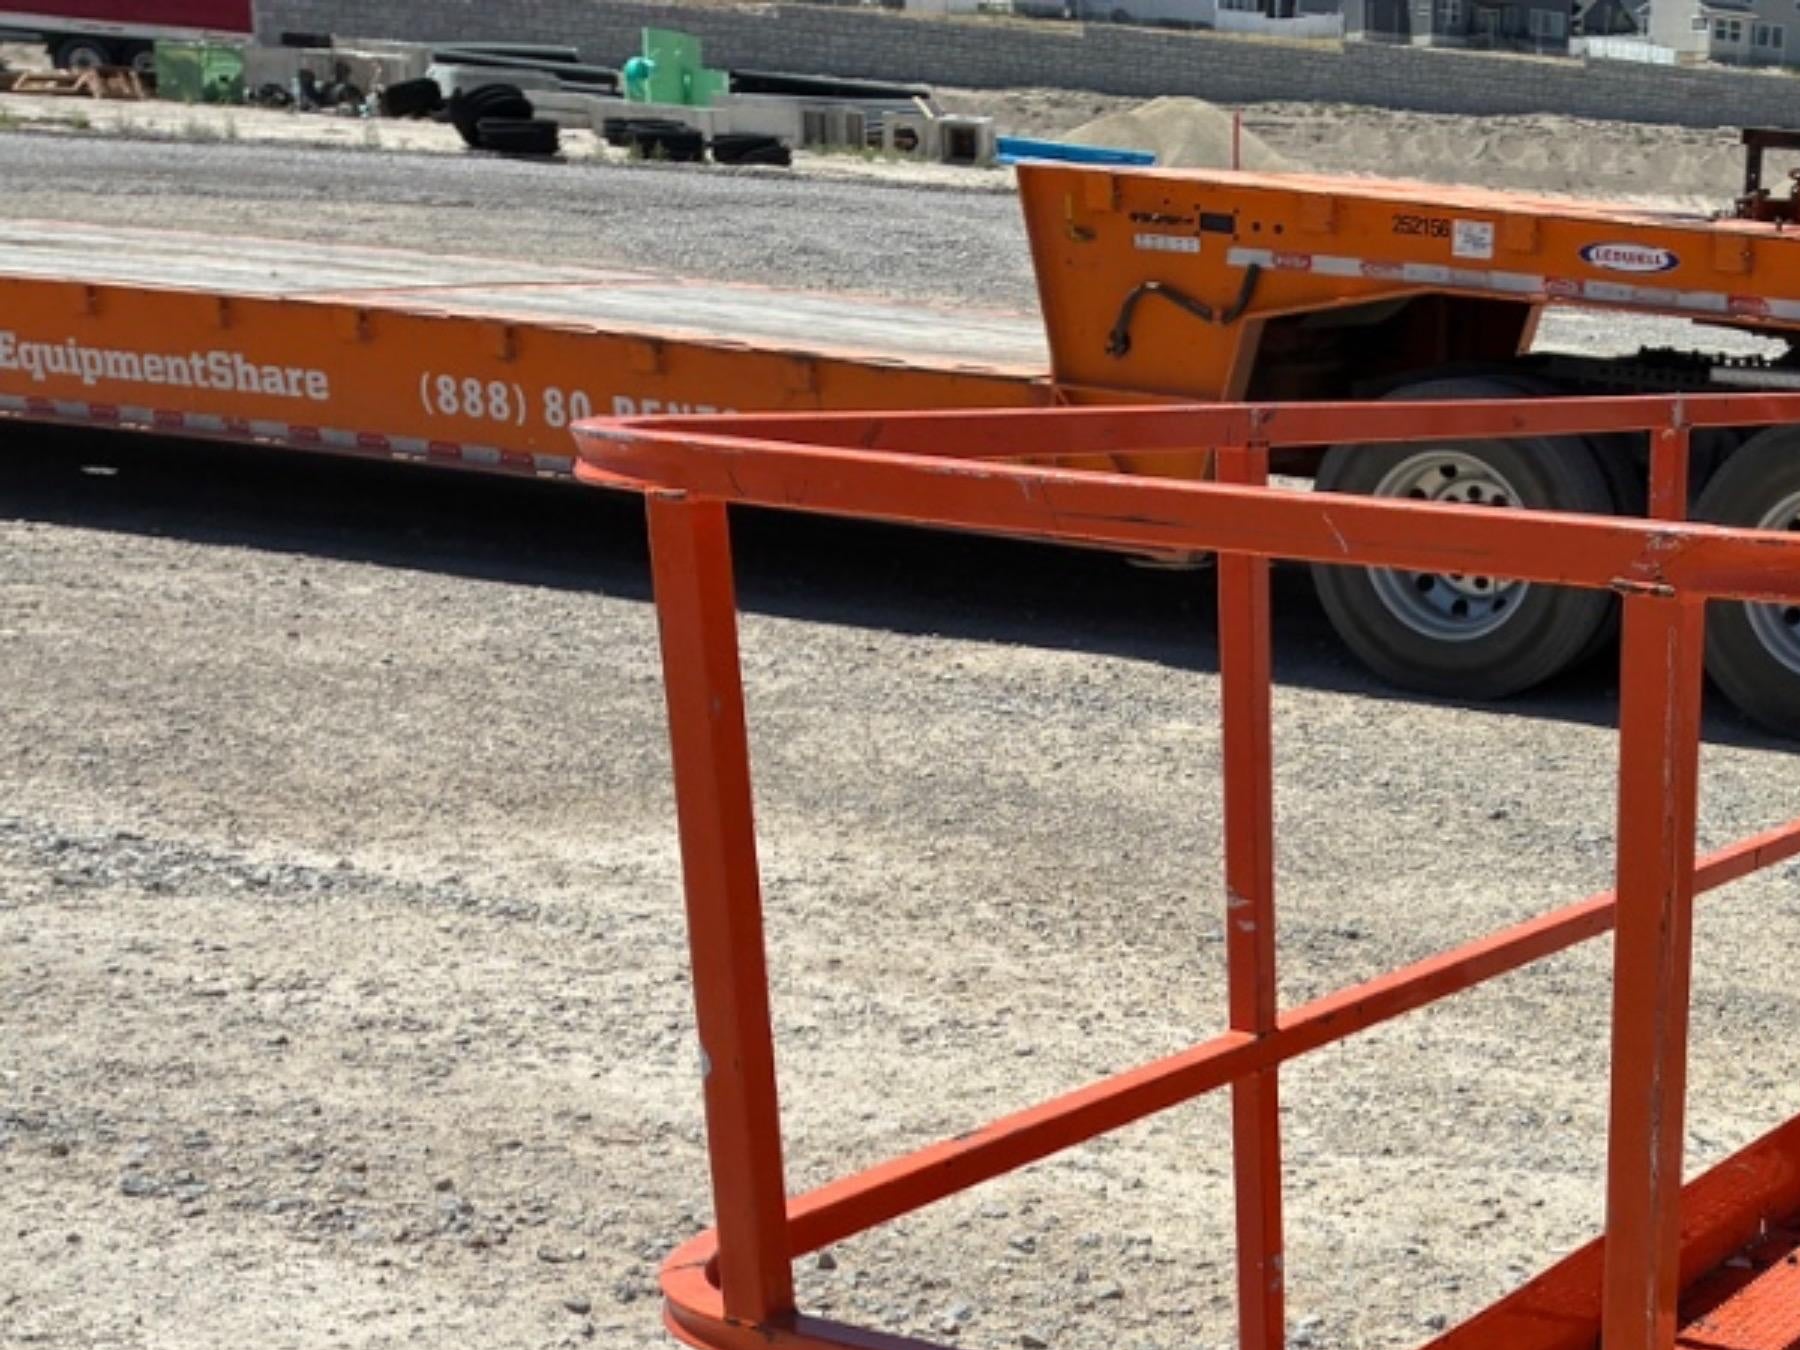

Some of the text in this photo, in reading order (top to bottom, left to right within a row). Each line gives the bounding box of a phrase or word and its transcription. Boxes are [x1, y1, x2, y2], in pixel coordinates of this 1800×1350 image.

[0, 330, 329, 400] EquipmentShare
[420, 371, 526, 426] (888)
[543, 386, 593, 427] 80
